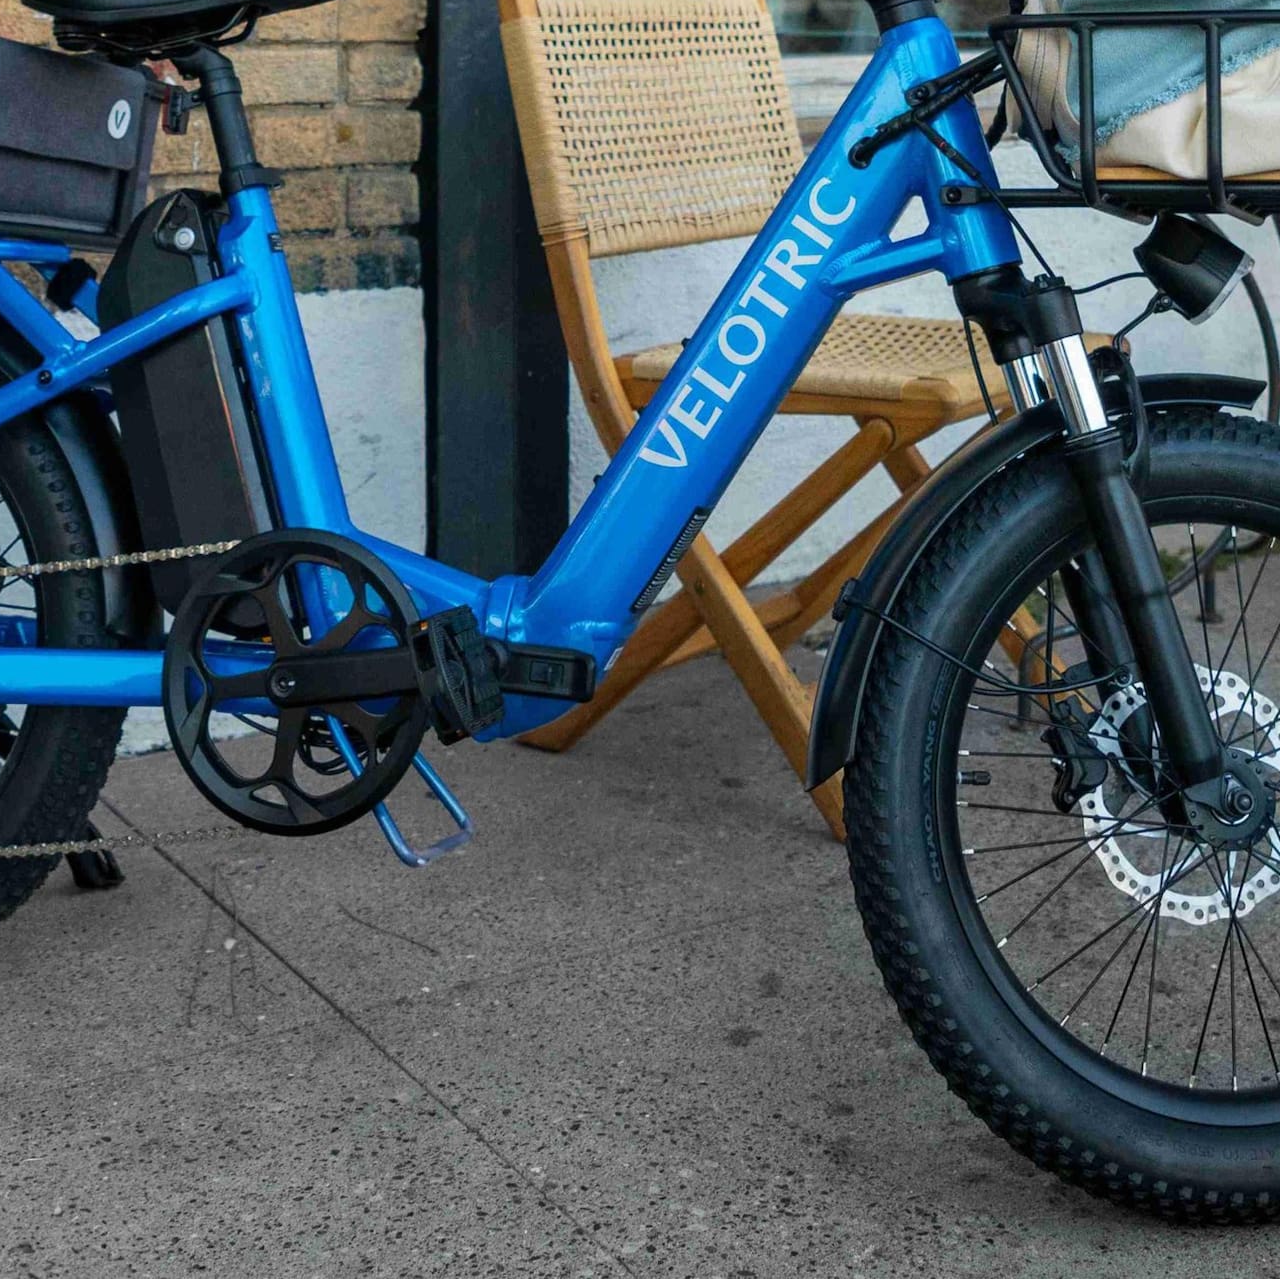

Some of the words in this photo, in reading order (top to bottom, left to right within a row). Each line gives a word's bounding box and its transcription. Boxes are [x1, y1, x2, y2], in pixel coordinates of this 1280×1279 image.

[638, 177, 857, 468] VELOTRIC
[922, 720, 937, 784] YANG
[924, 812, 941, 882] CHAO
